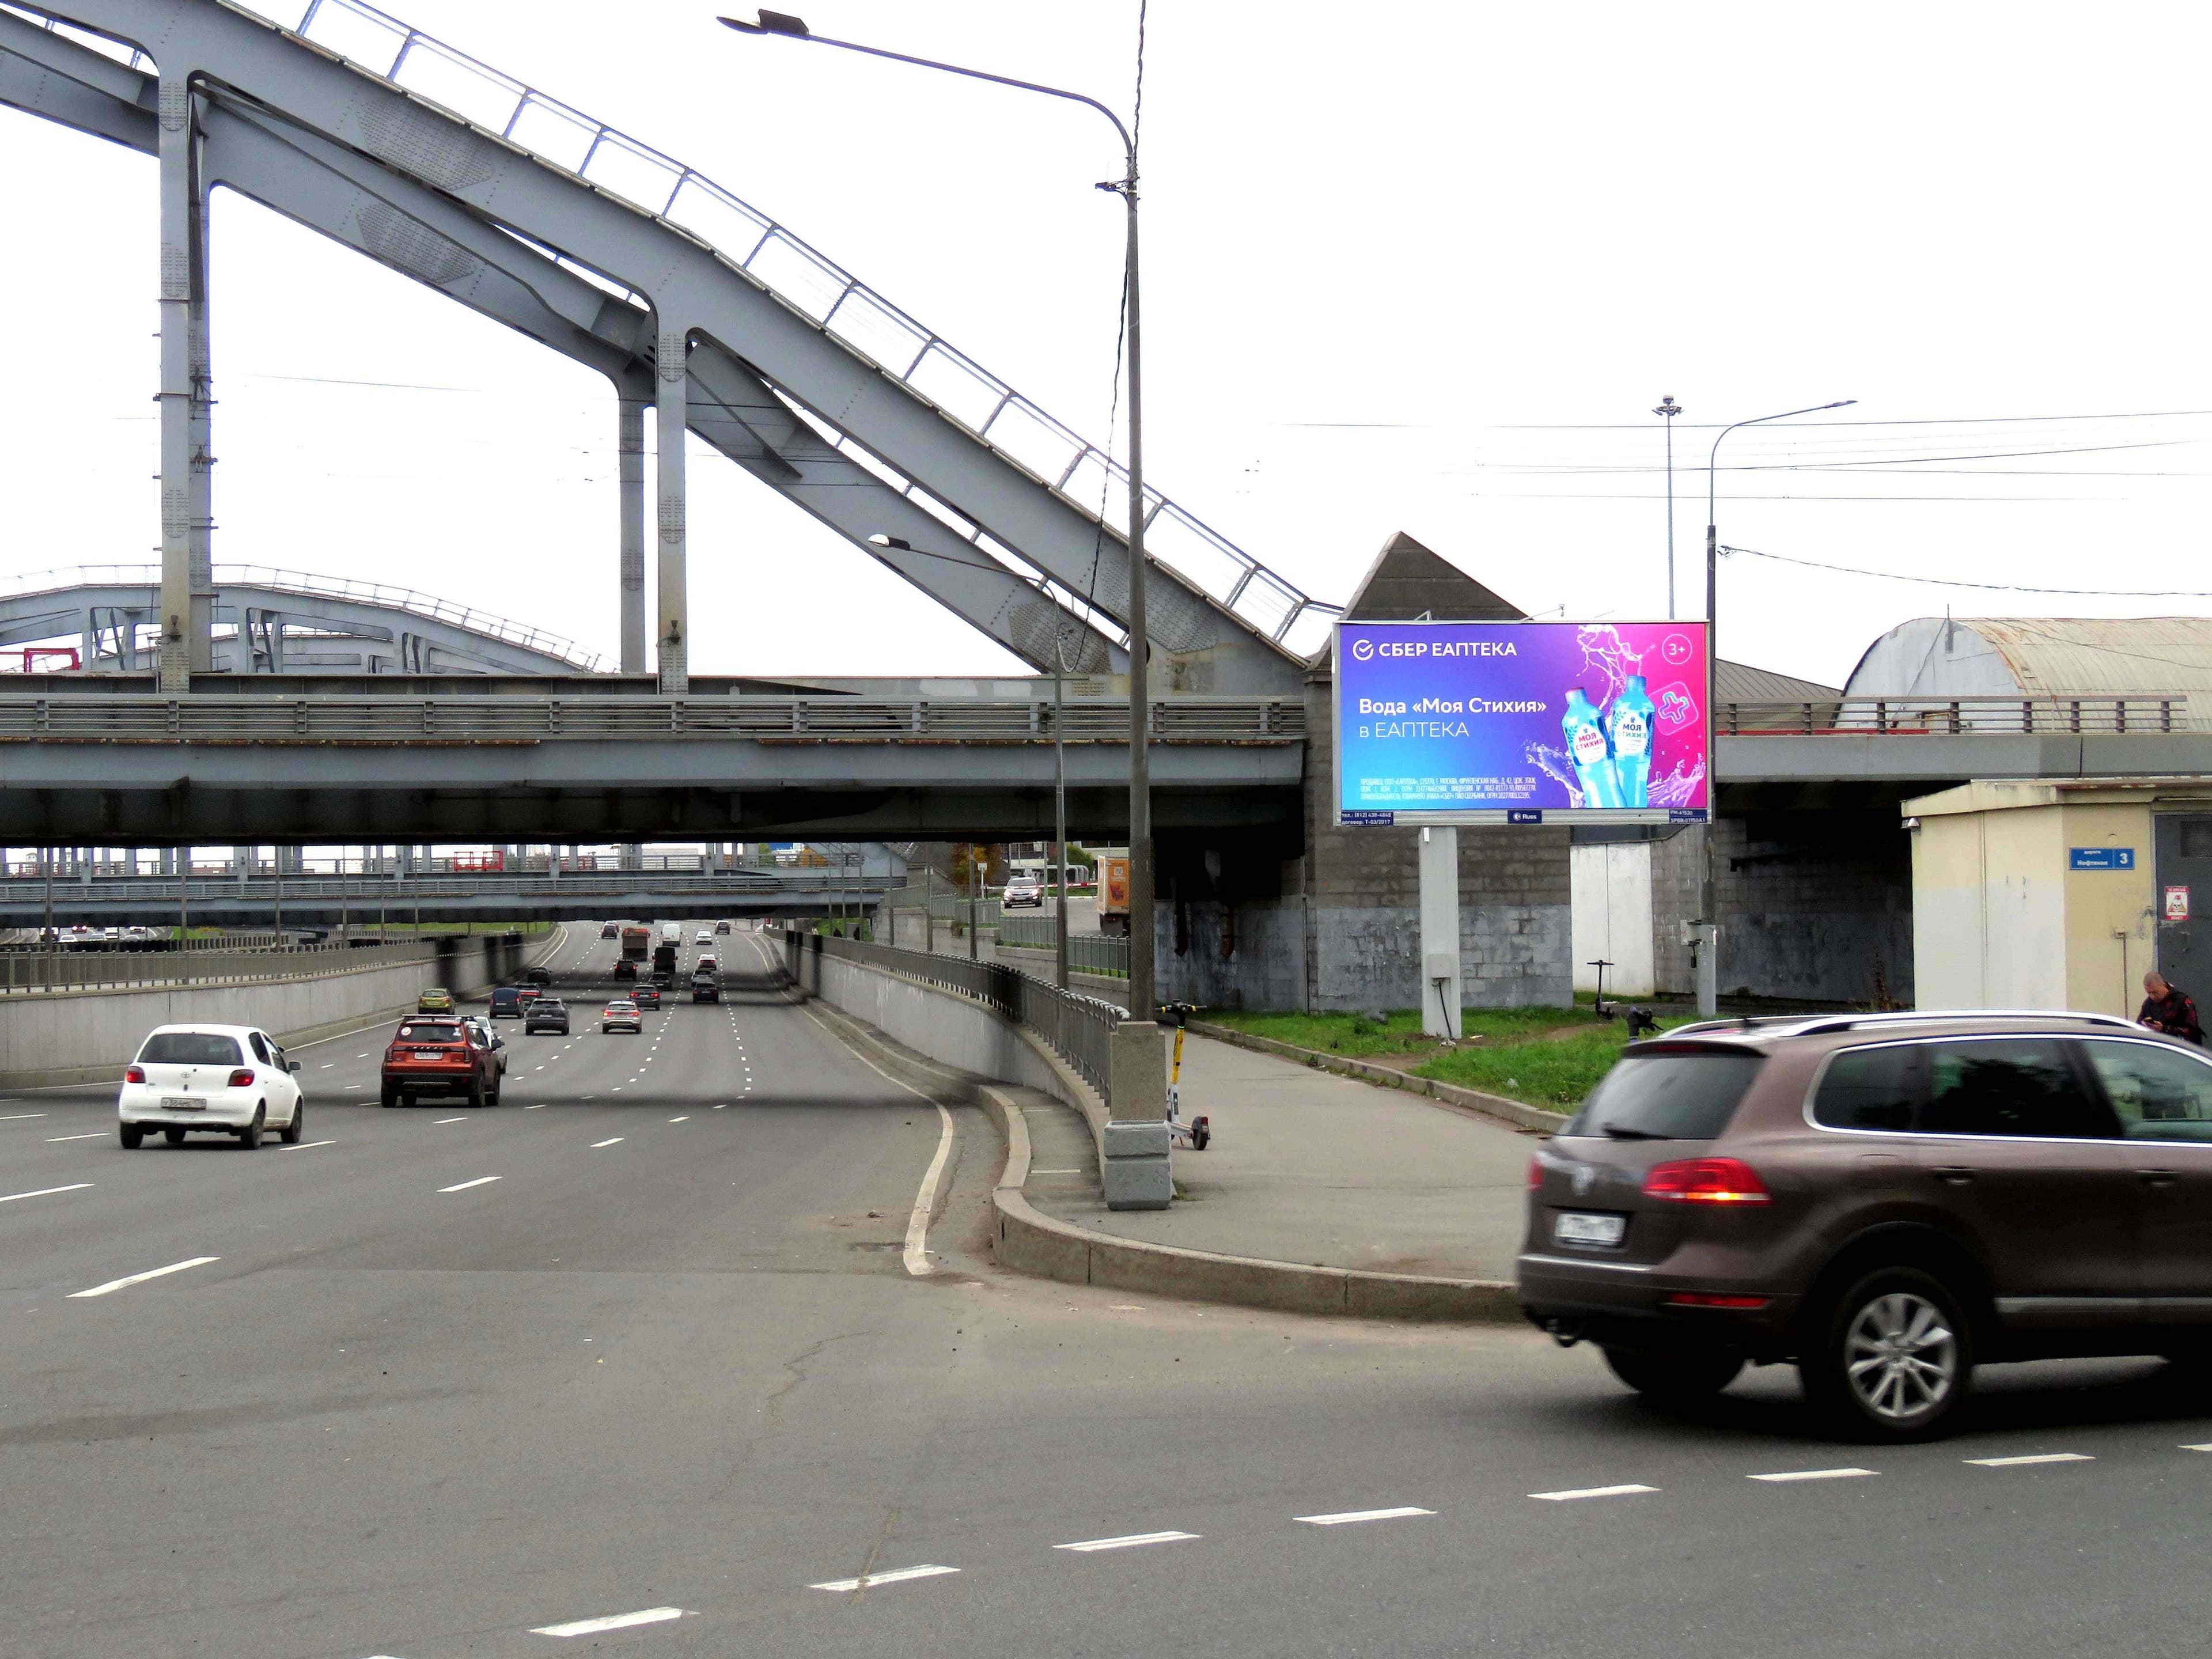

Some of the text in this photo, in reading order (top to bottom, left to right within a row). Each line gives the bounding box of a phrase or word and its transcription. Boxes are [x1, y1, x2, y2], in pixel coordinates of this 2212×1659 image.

[1378, 642, 1517, 657] СБЕР ЕАПТЕКА
[1668, 643, 1685, 656] 3+
[1359, 697, 1547, 716] Вода «Моя Стихия»
[1359, 722, 1469, 738] в ЕАПТЕКА
[1623, 724, 1642, 732] МОЯ
[1578, 732, 1597, 743] МОЯ
[1616, 731, 1646, 739] СТИХИЯ
[1575, 738, 1604, 751] СТИХИЯ
[2119, 852, 2128, 865] 3
